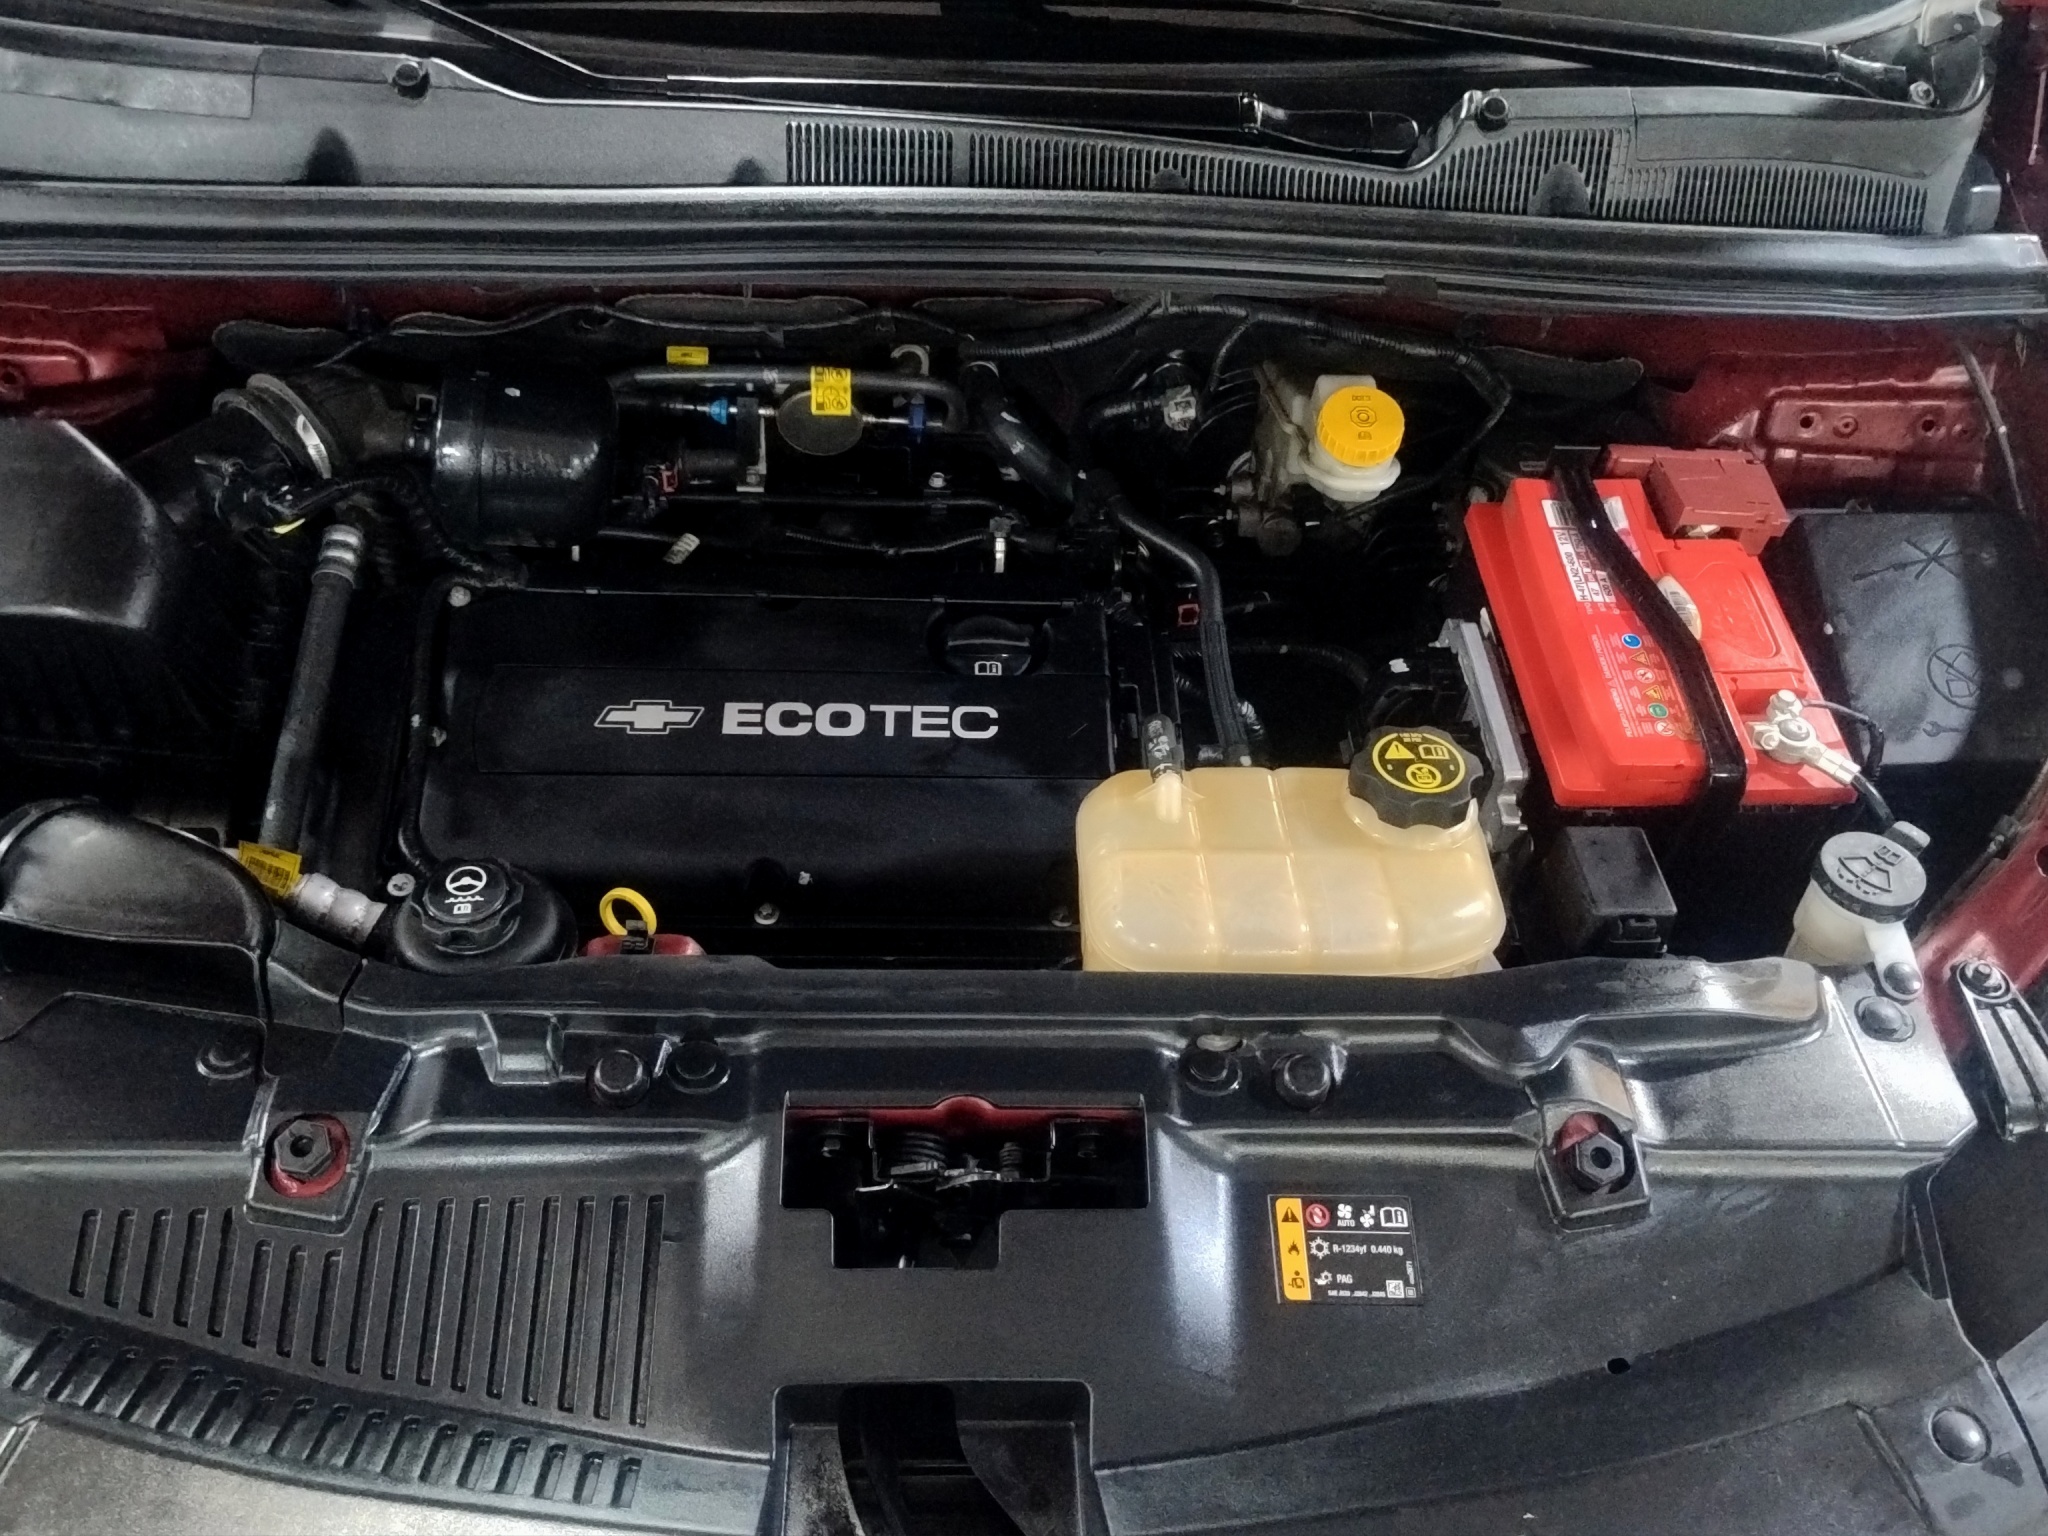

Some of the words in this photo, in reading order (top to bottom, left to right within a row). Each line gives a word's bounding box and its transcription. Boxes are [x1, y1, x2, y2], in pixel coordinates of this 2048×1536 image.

[722, 701, 999, 739] ECOTEC
[1337, 1219, 1356, 1227] AUTO
[1333, 1244, 1367, 1255] R-1234yf
[1370, 1245, 1393, 1254] 0.440
[1393, 1245, 1404, 1256] kg
[1336, 1273, 1353, 1284] PAG
